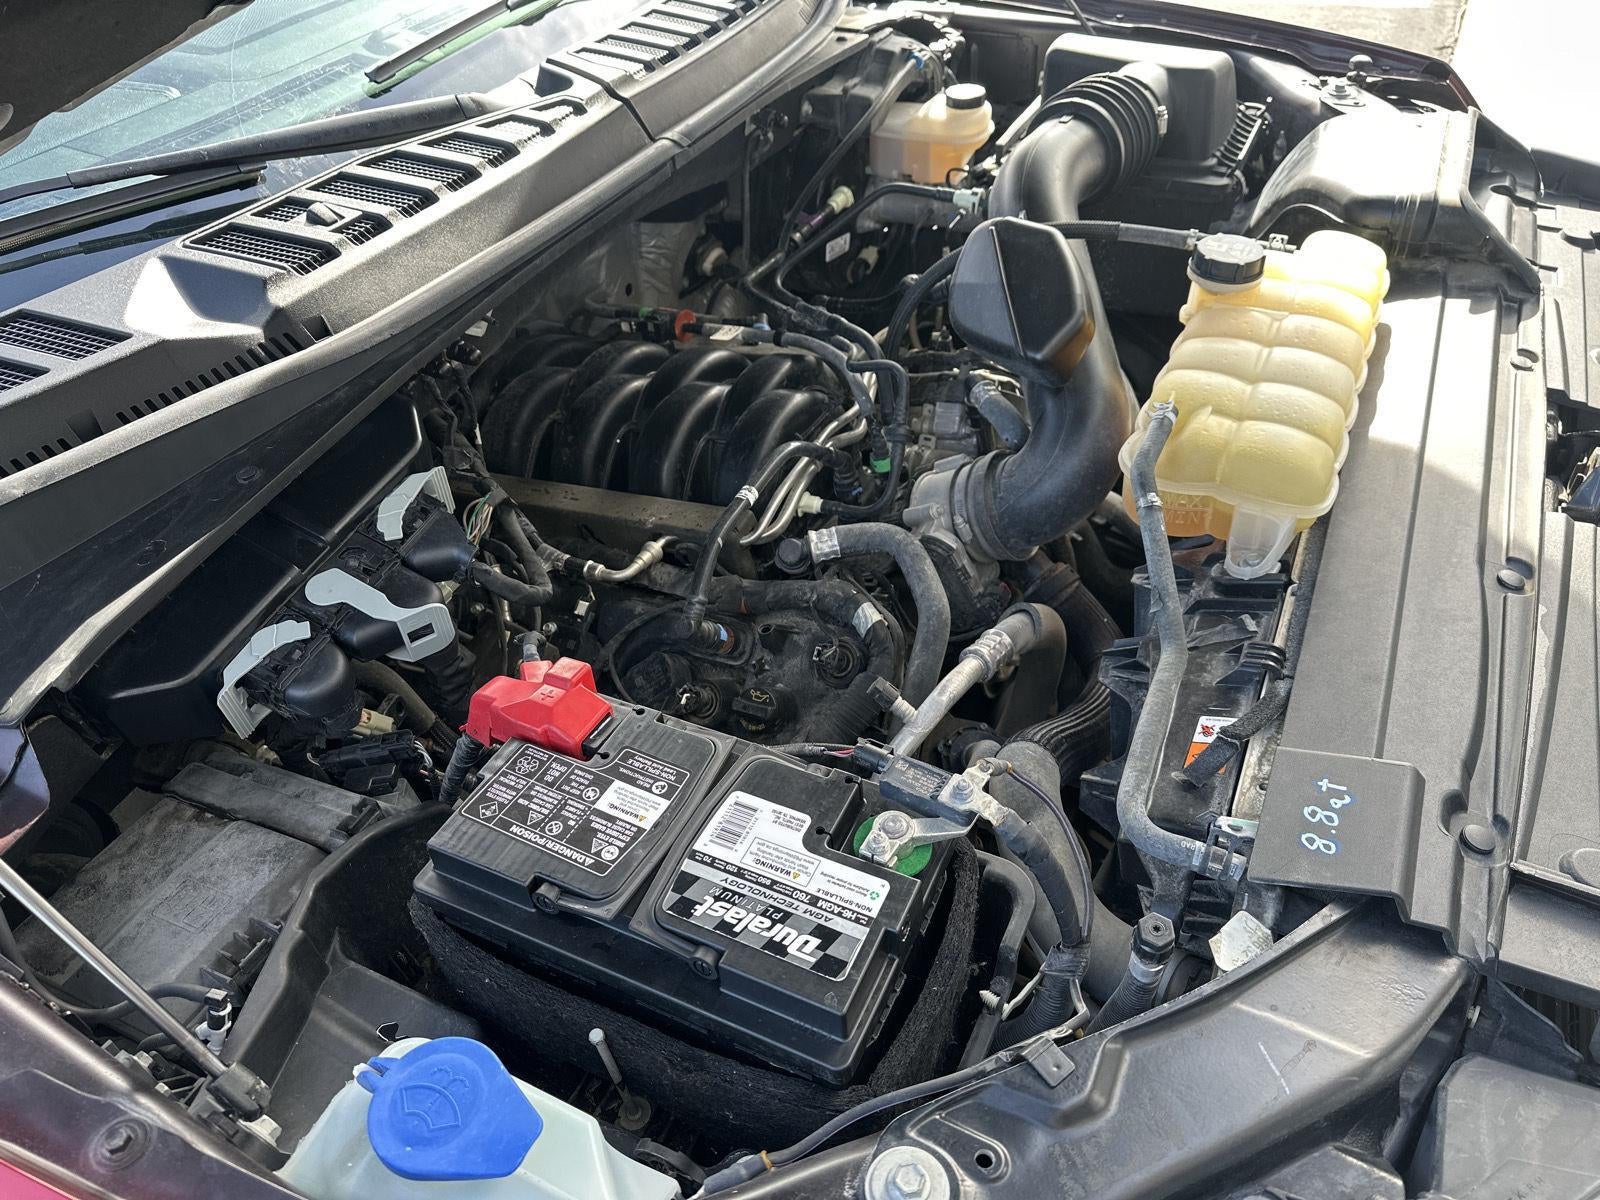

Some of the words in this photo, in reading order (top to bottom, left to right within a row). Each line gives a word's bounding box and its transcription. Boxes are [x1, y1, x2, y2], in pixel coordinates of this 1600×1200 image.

[546, 768, 560, 776] NOT
[625, 758, 676, 780] NON-SPILLABLE
[607, 803, 640, 821] WARNING:
[509, 824, 589, 863] DANGER/POISON
[1180, 840, 1196, 850] RAD
[725, 863, 738, 872] 120
[751, 856, 792, 876] WARNING:
[757, 875, 771, 885] 950
[707, 884, 783, 920] PLATINUM
[718, 874, 801, 911] TECHNOLOGY
[791, 888, 812, 903] 760
[815, 887, 872, 912] NON-SPILLABLE
[802, 907, 833, 924] AGM
[816, 898, 857, 920] H6-AGM
[690, 894, 823, 962] Duralast
